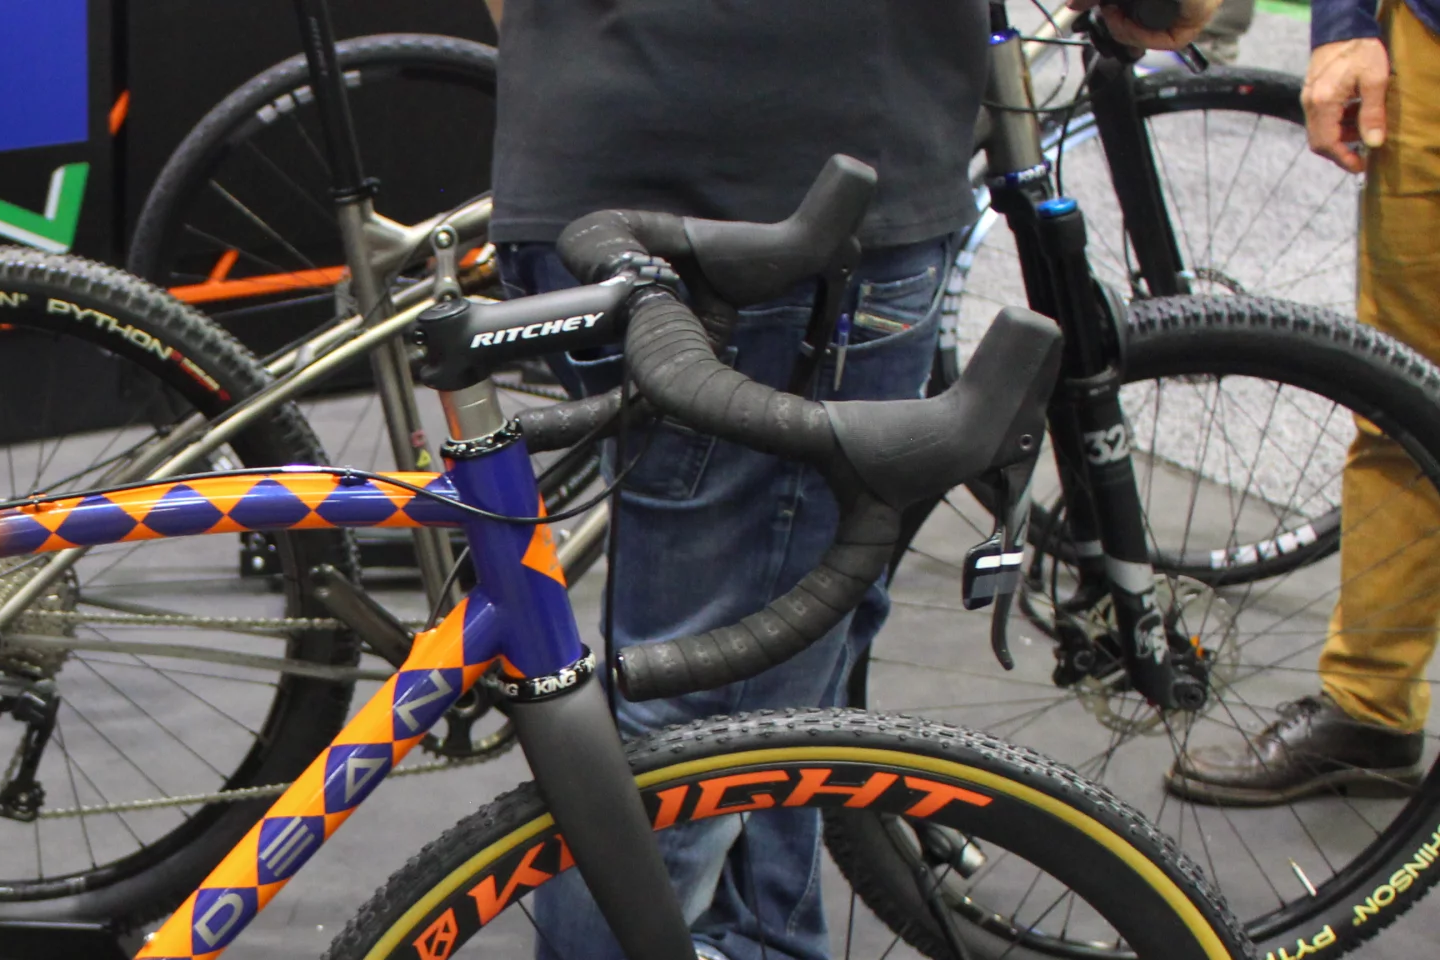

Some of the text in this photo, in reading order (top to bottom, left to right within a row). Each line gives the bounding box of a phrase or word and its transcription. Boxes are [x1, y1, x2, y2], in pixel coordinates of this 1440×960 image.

[46, 299, 173, 361] PYTHON
[470, 311, 605, 348] RITCHEY
[1084, 424, 1126, 466] 32
[534, 669, 577, 696] KING
[193, 669, 454, 948] DEAN
[467, 769, 994, 926] KIGHT
[1353, 824, 1440, 922] HINSON
